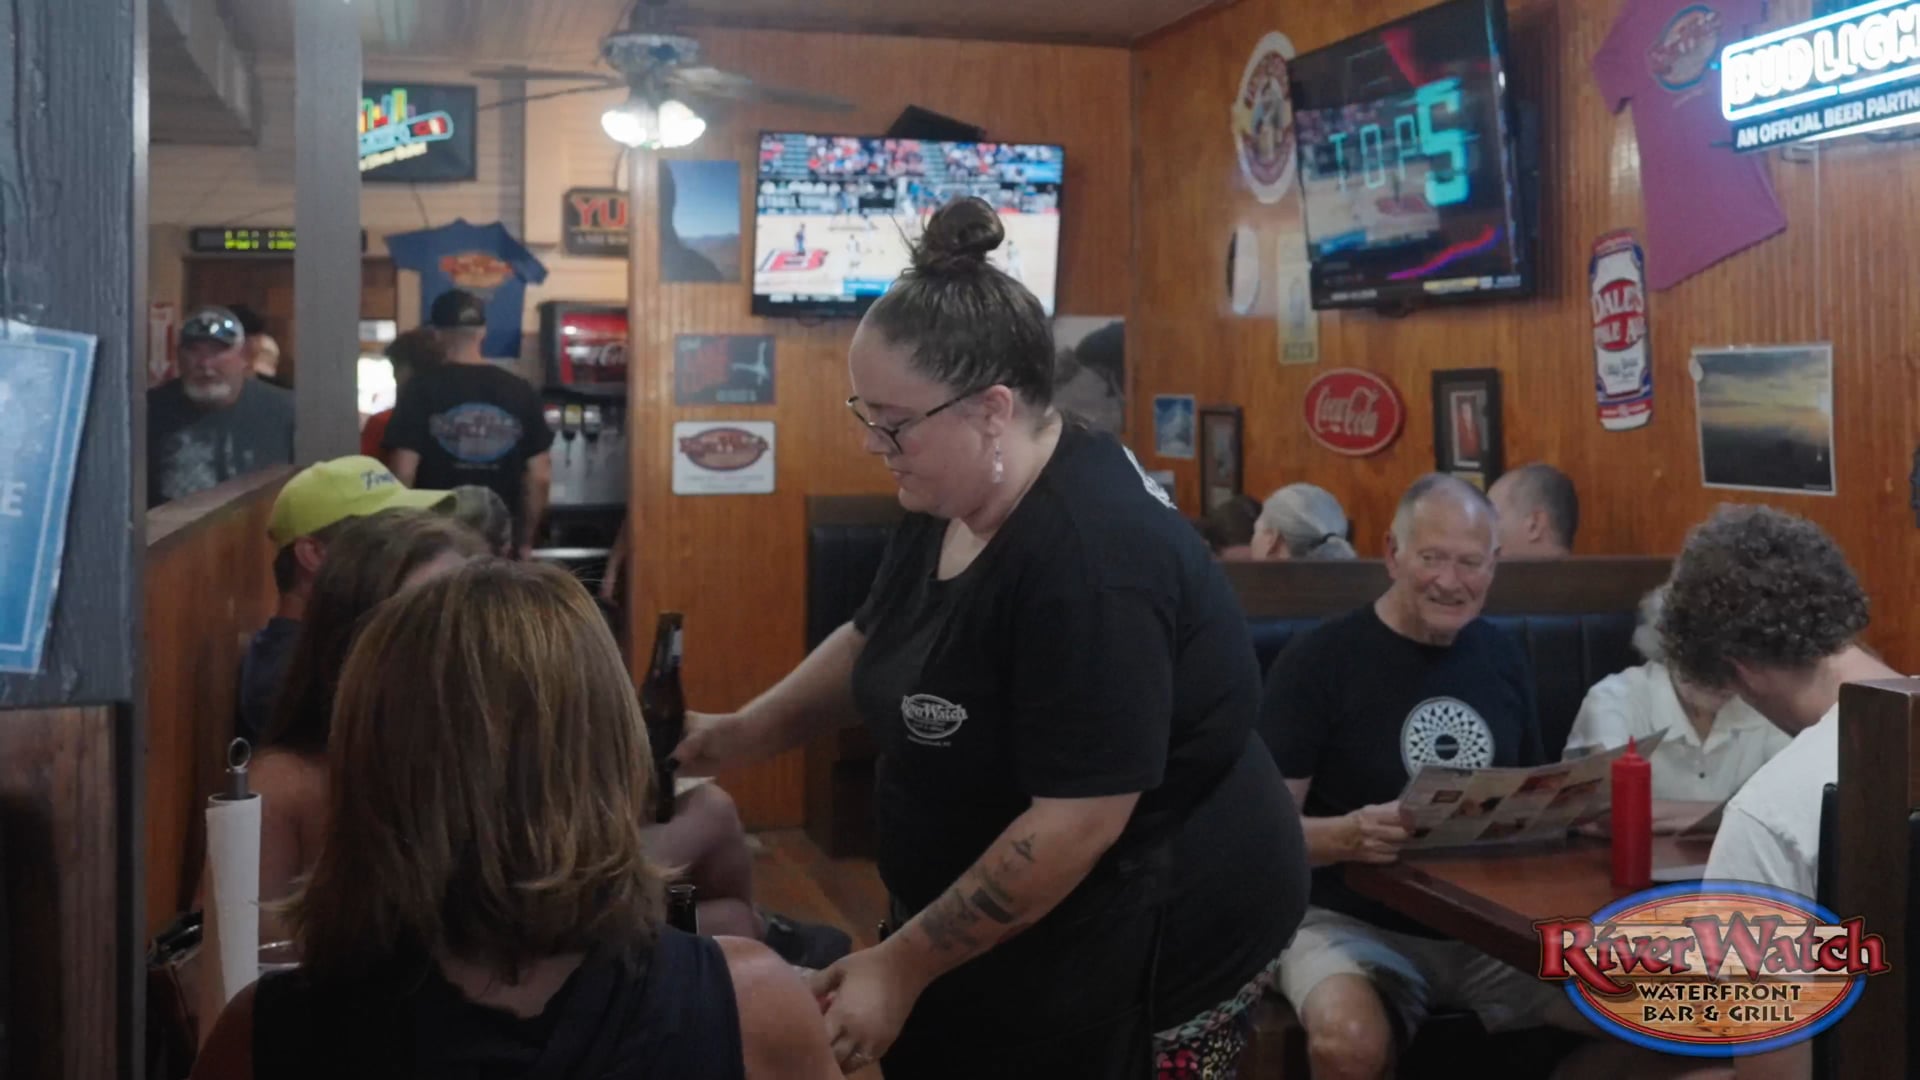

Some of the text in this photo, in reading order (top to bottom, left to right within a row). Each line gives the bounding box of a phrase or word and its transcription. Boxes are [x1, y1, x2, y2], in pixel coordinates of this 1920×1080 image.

[1729, 37, 1814, 105] BUD
[1328, 76, 1470, 207] TOP 5
[1737, 126, 1758, 148] AN
[1759, 111, 1823, 144] OFFICIAL
[1823, 101, 1864, 128] BEER
